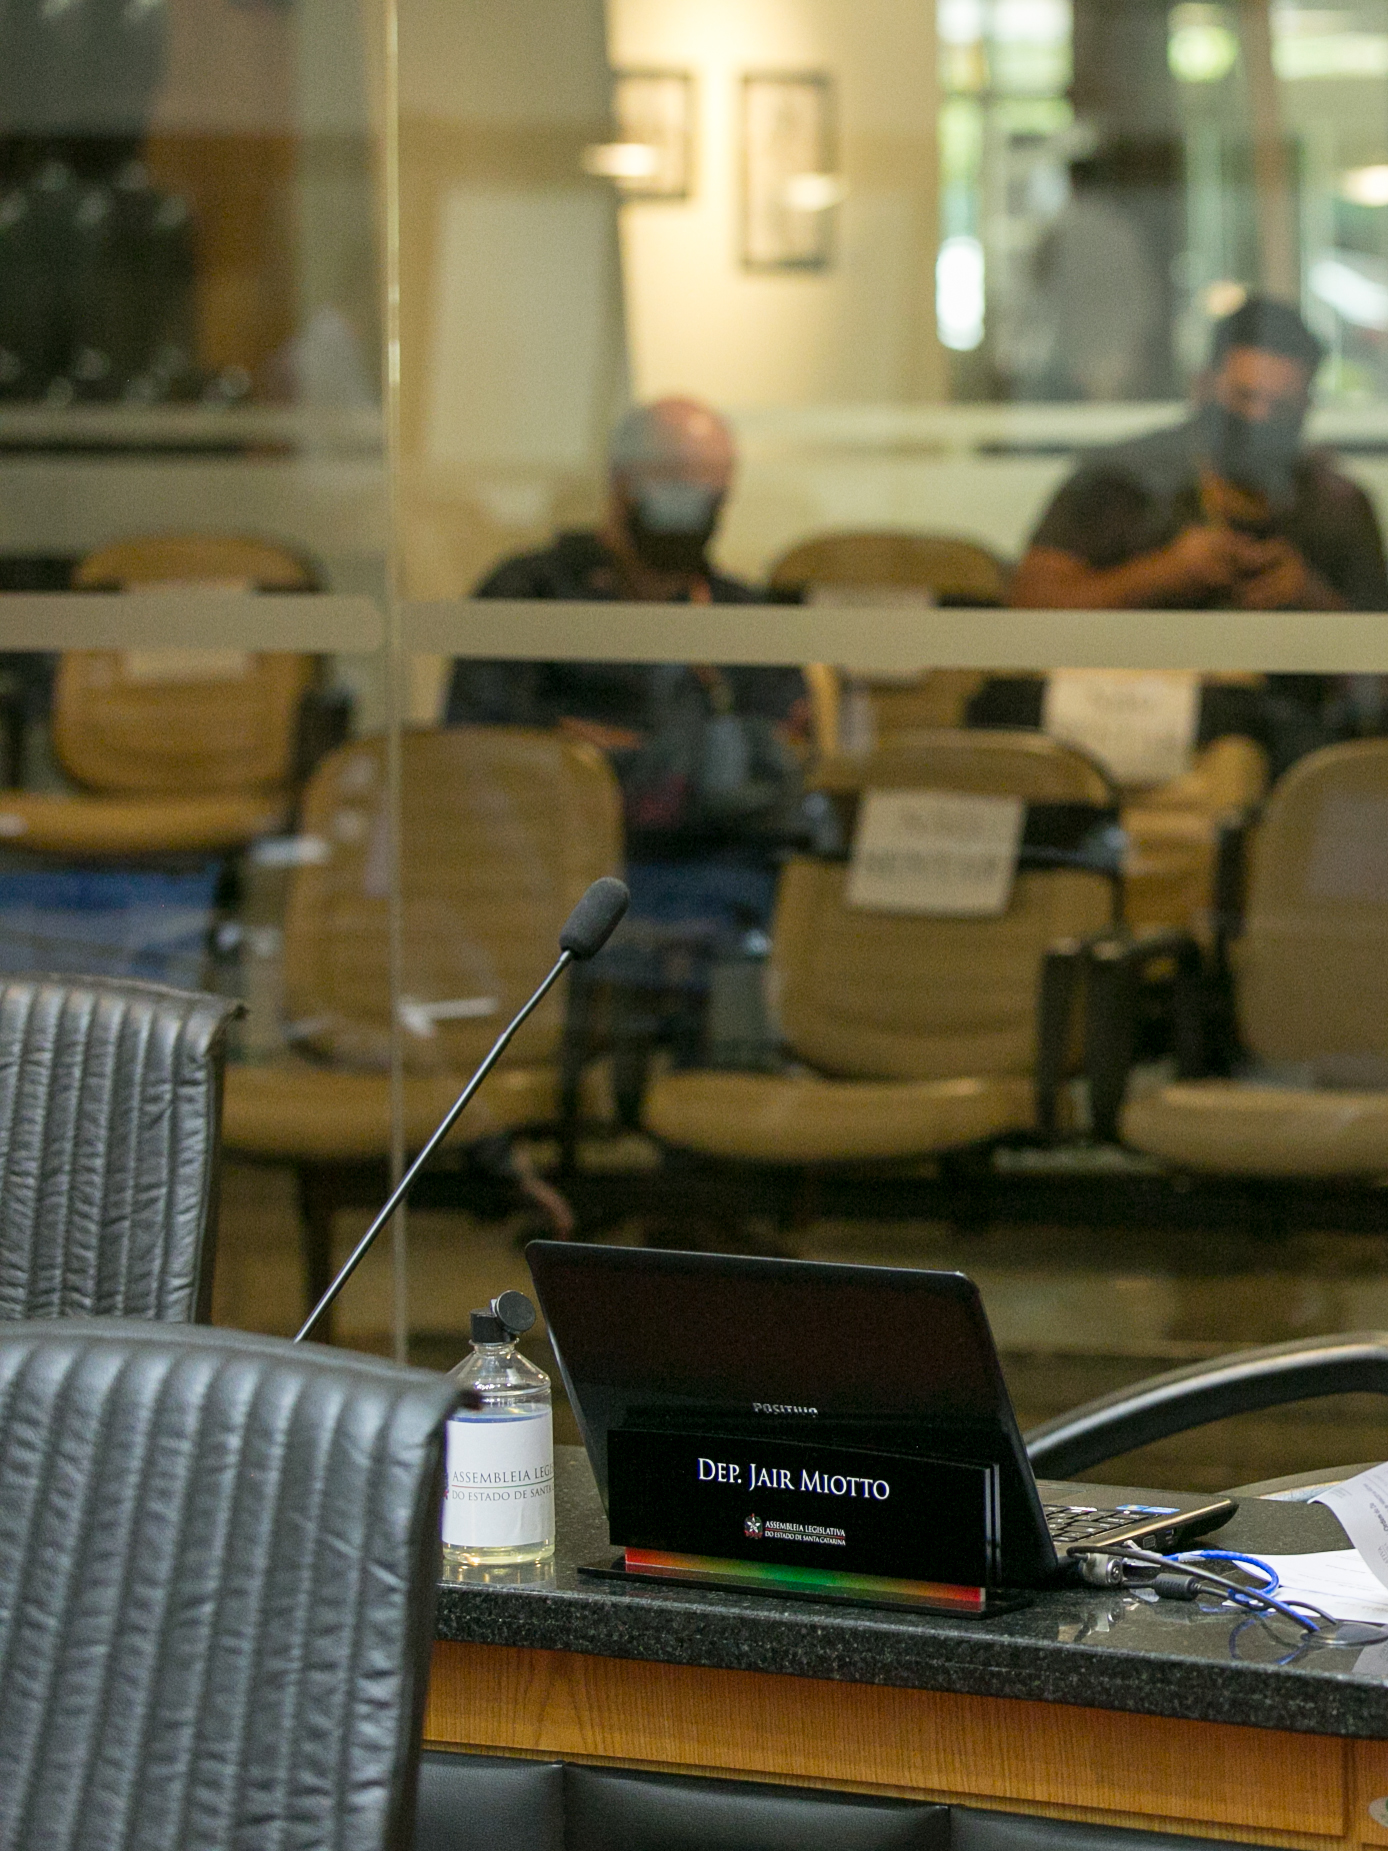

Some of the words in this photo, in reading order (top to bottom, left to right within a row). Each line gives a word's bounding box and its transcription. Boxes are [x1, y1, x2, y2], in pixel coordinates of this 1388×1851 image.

[452, 1469, 531, 1484] ASSEMBLEIA
[749, 1463, 795, 1491] JAIR
[800, 1469, 890, 1500] MIOTTO
[452, 1489, 465, 1500] DO
[468, 1490, 510, 1501] ESTADO
[514, 1489, 527, 1500] DE
[765, 1520, 804, 1532] ASSEMBLEIA
[805, 1524, 846, 1537] LEGISLATIVA
[774, 1532, 795, 1541] ESTADO
[803, 1535, 820, 1543] SANTA
[819, 1536, 846, 1546] CATARINA
